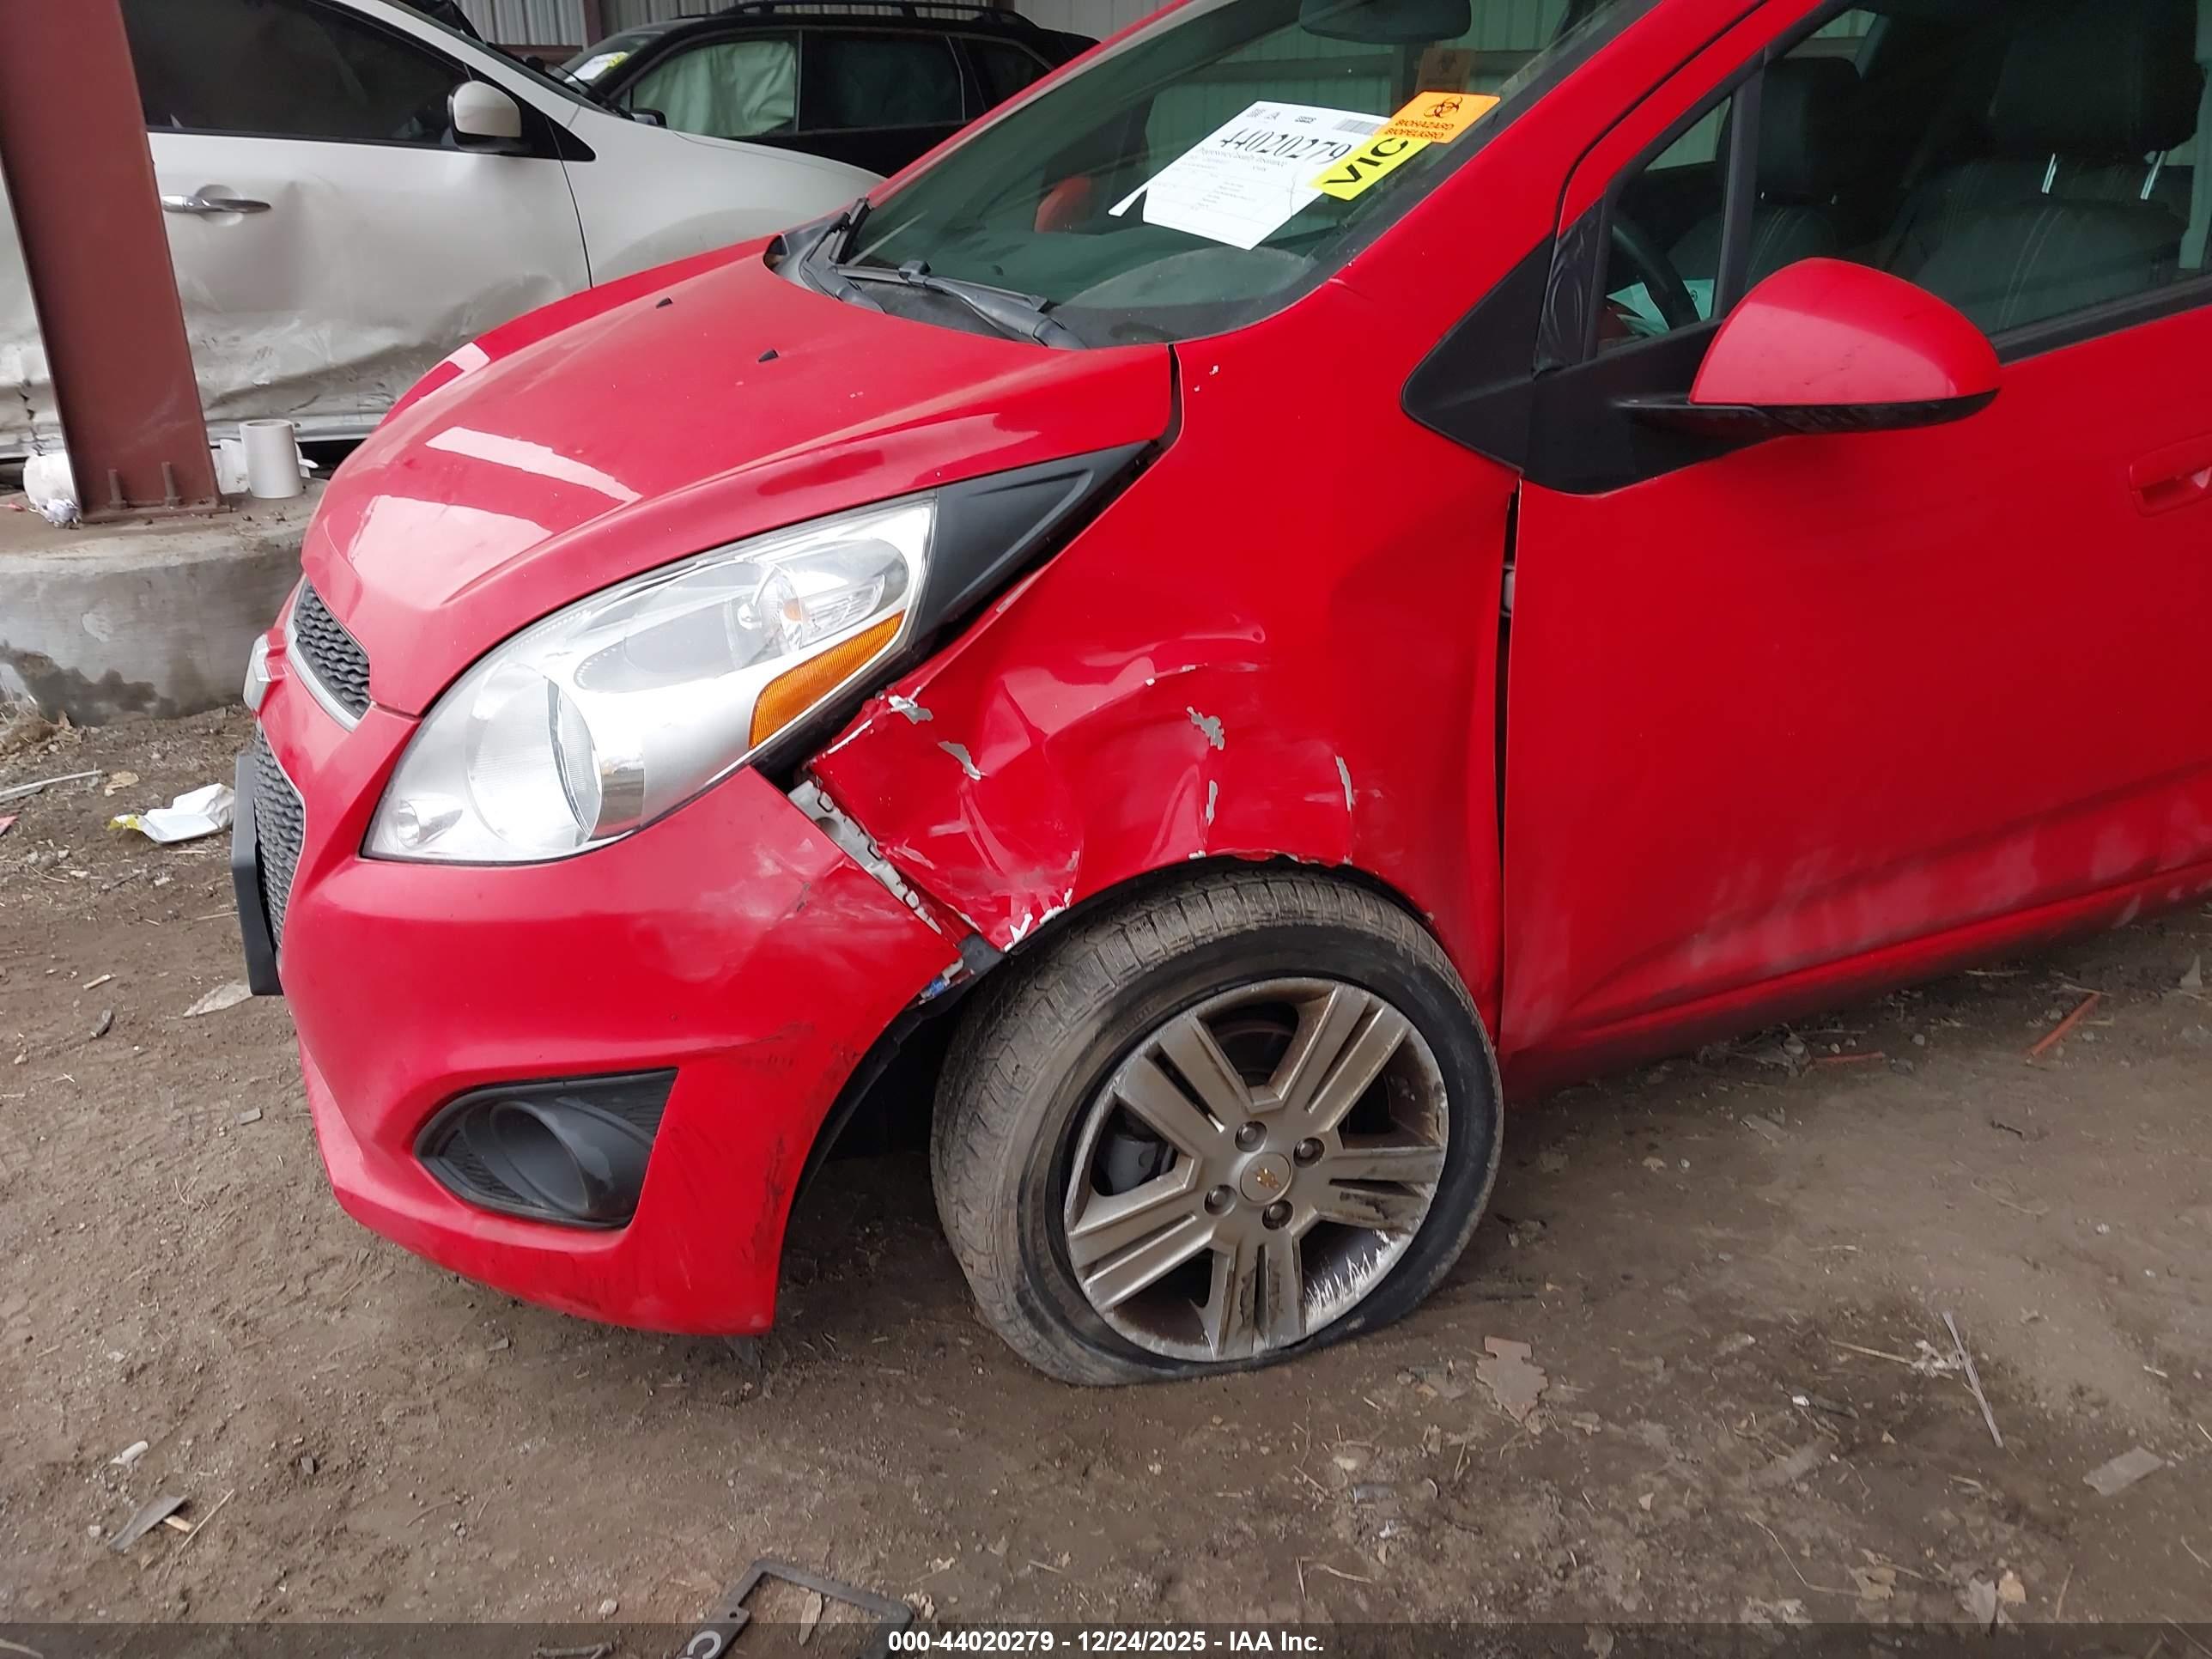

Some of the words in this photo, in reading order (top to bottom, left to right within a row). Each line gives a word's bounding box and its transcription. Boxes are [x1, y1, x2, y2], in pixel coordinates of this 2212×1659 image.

[1395, 118, 1455, 131] BIOHAZARD
[1219, 127, 1352, 165] 44020279
[1323, 137, 1409, 185] VIC
